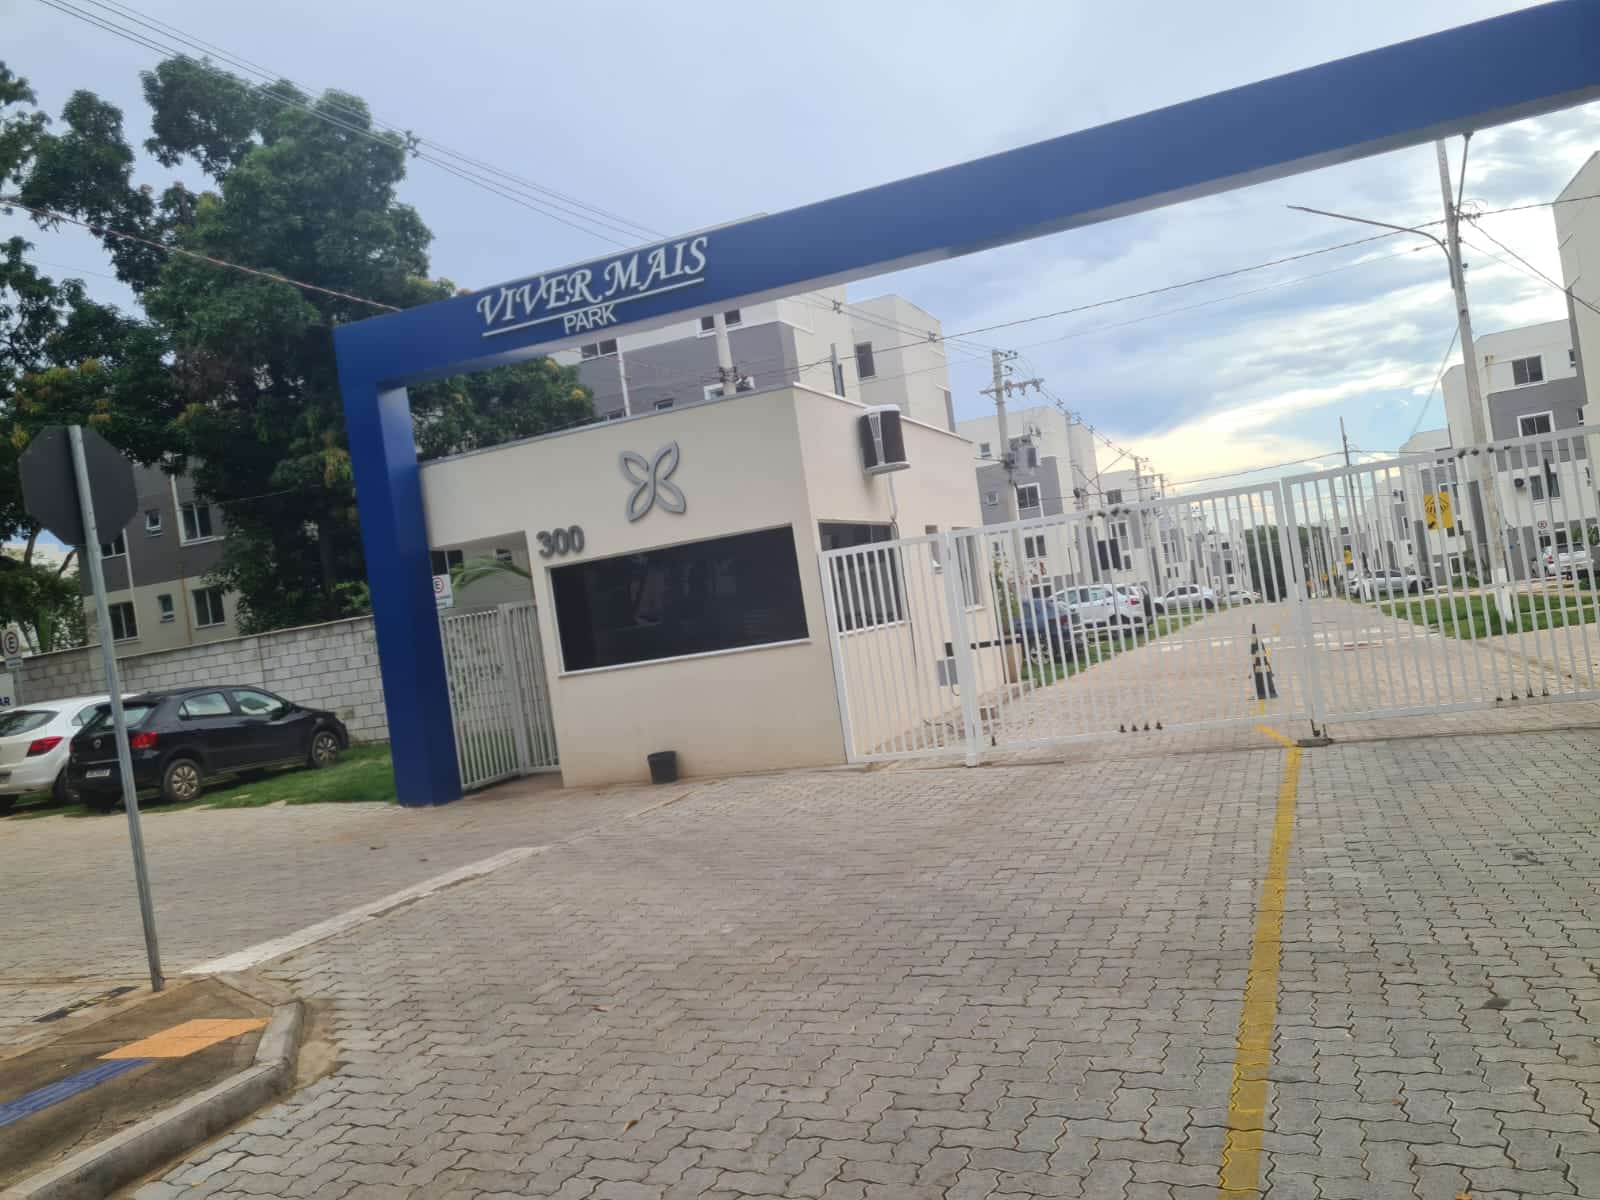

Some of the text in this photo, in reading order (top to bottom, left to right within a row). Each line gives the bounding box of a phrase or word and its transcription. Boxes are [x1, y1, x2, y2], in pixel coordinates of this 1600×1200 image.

[476, 236, 708, 325] VIVER MAIS
[563, 303, 617, 334] PARK
[536, 525, 585, 558] 300
